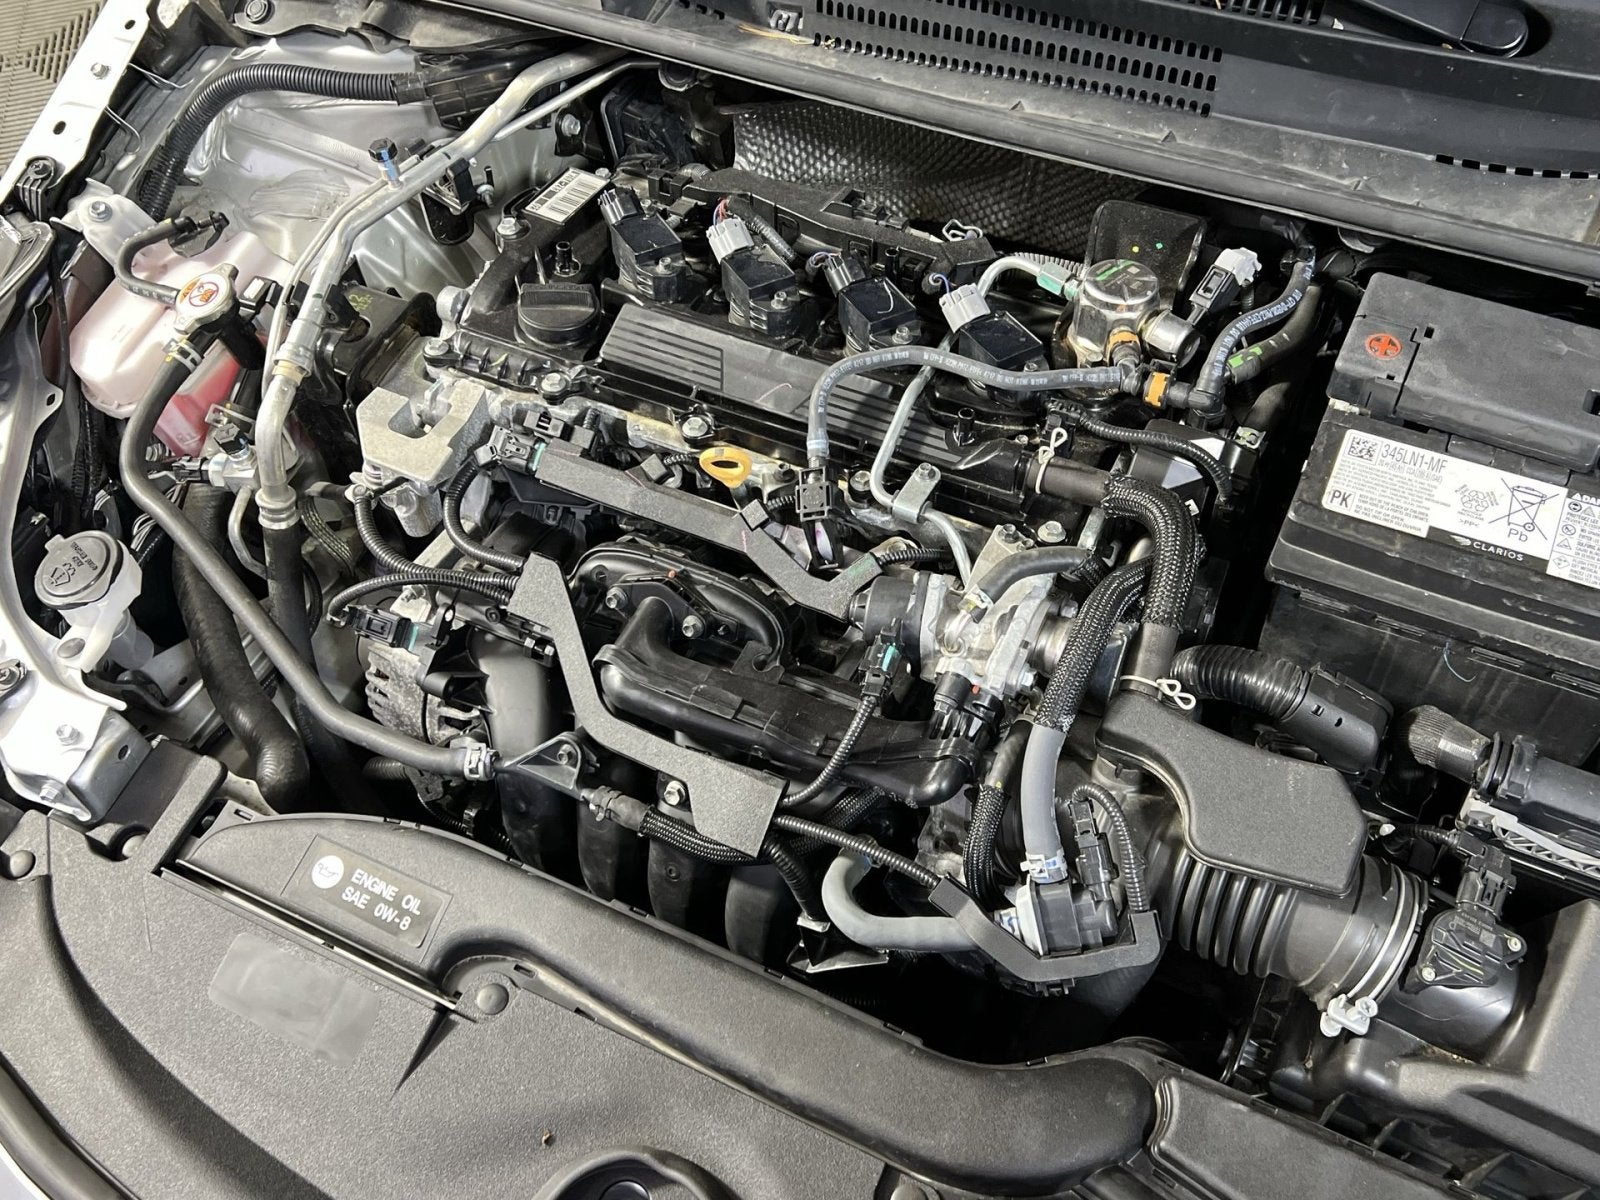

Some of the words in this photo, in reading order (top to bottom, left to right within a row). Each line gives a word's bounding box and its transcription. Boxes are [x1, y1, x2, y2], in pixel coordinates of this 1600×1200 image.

[1382, 444, 1448, 473] 345LN1-MF
[1330, 490, 1350, 508] PK
[1508, 529, 1528, 542] Pb
[1473, 542, 1524, 561] CLARIOS
[351, 869, 399, 901] ENGINE
[402, 895, 421, 915] OIL
[342, 887, 370, 909] SAE
[374, 903, 411, 930] 0W-8
